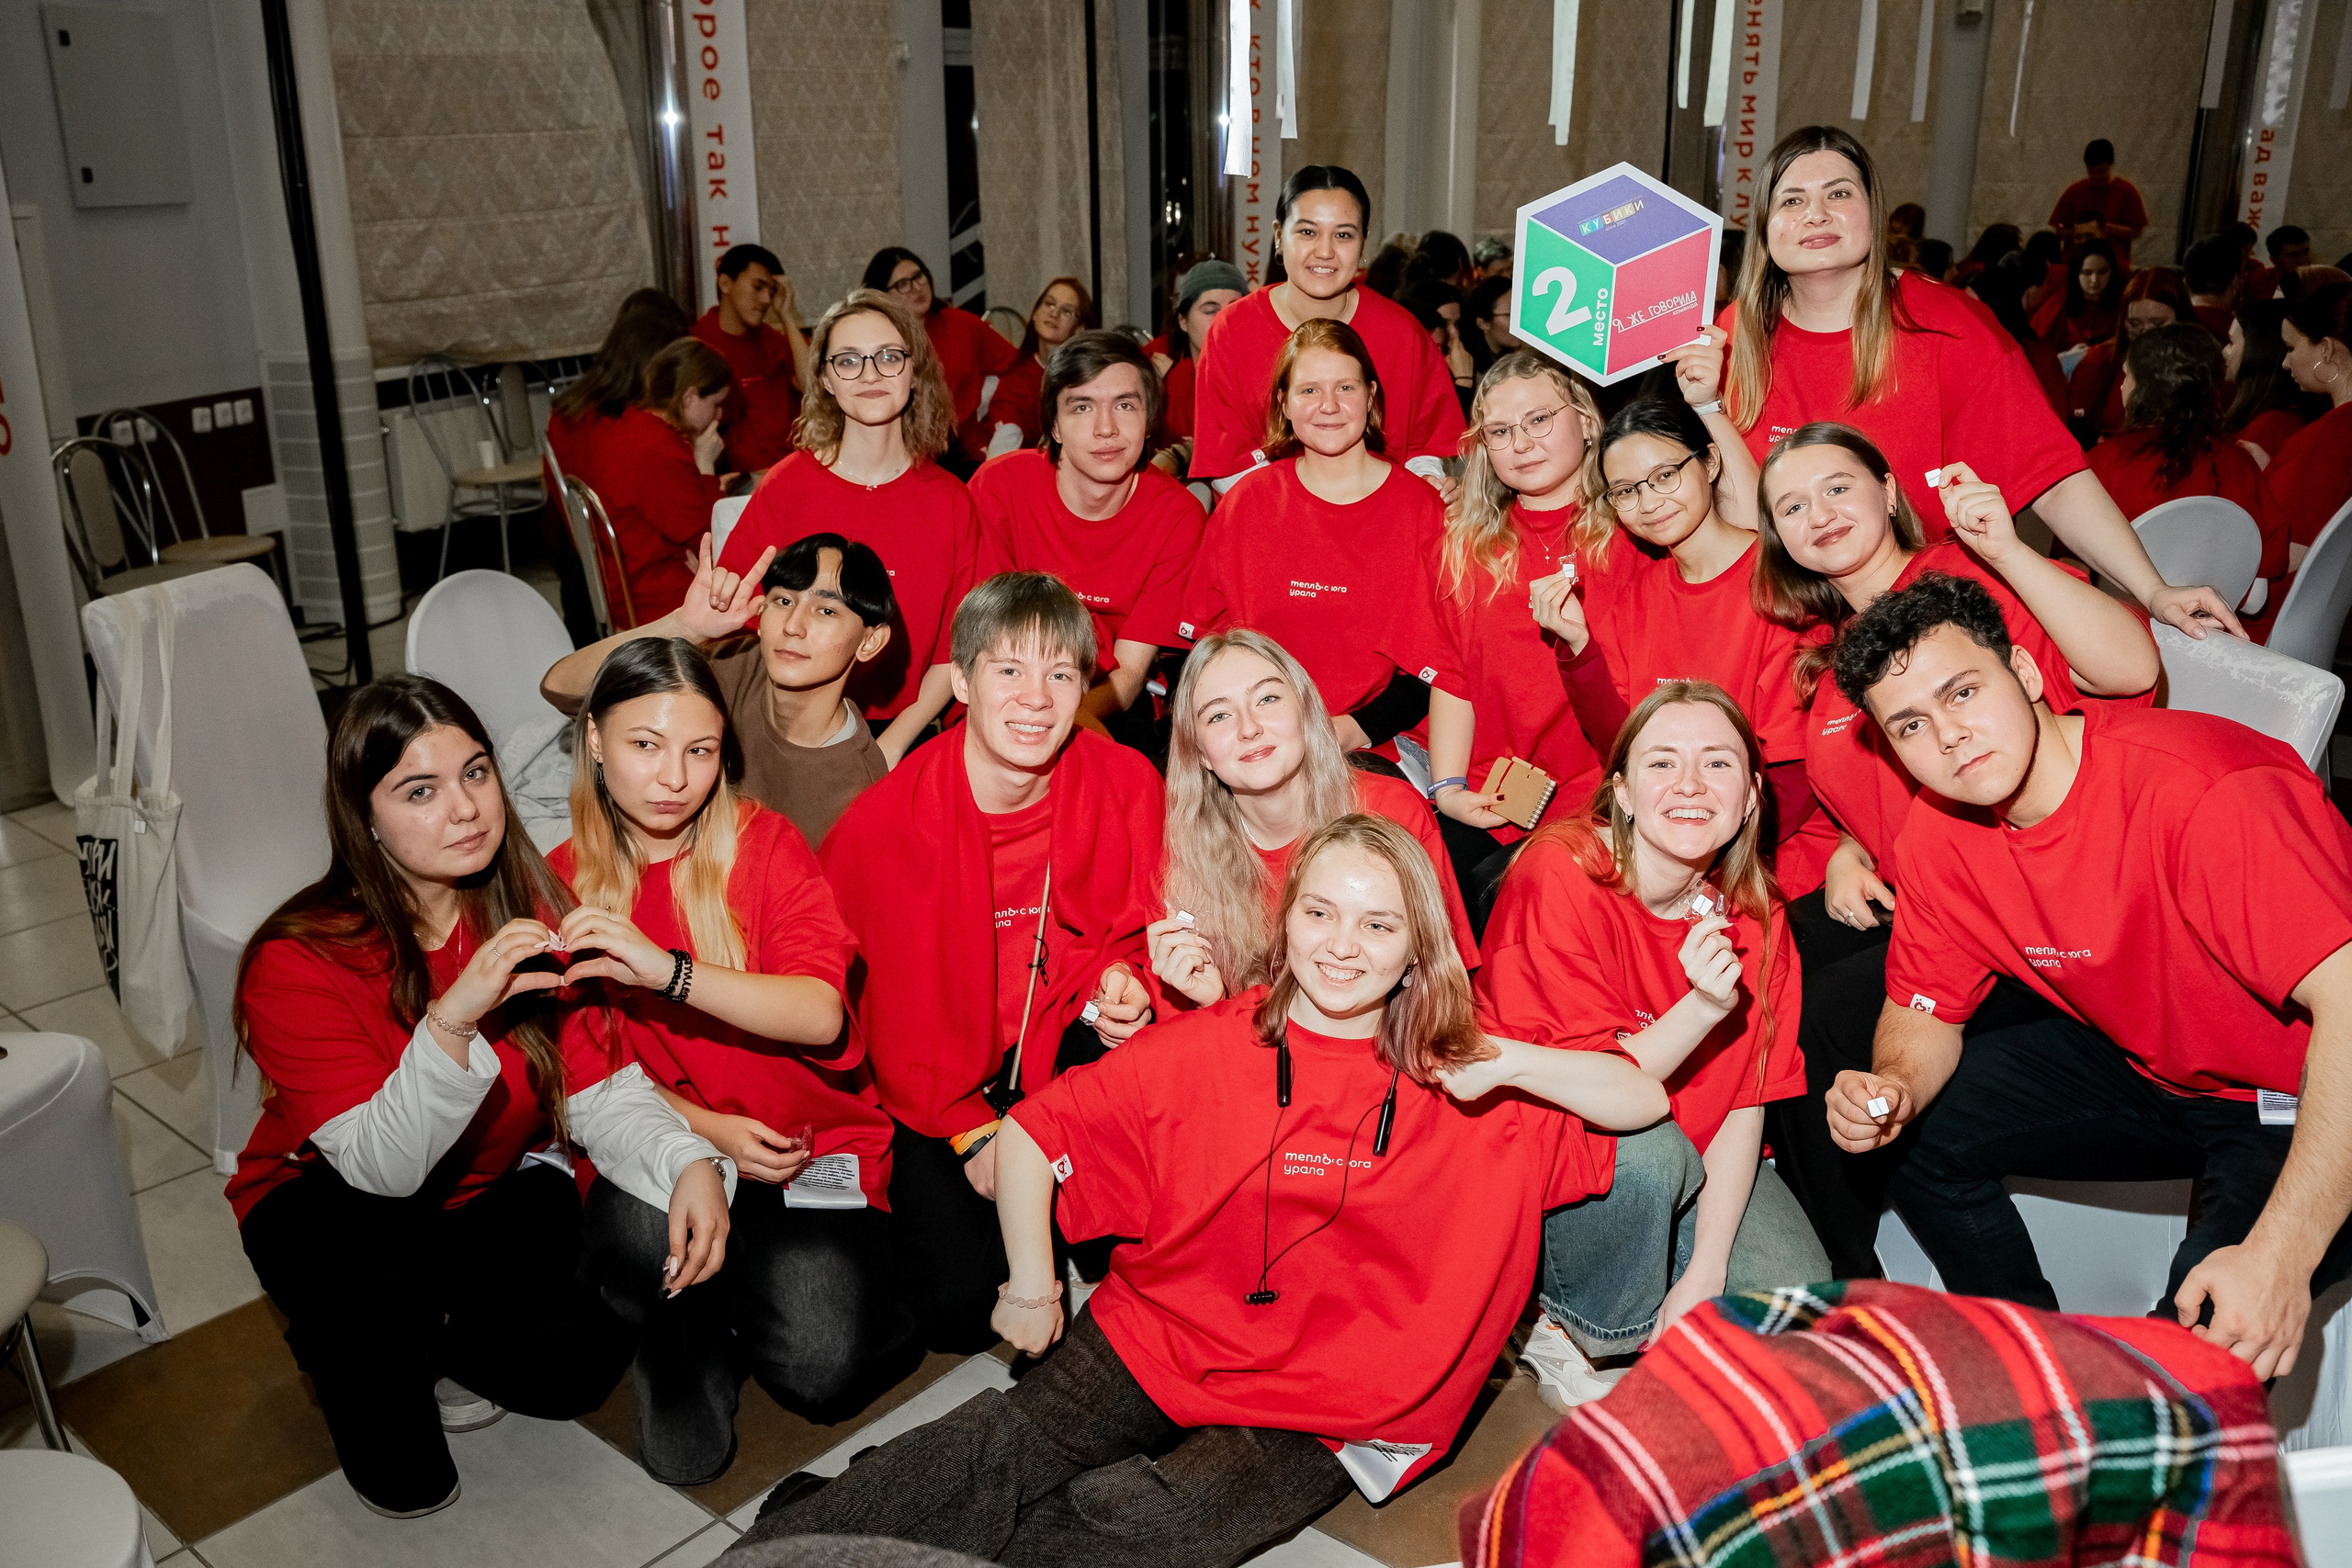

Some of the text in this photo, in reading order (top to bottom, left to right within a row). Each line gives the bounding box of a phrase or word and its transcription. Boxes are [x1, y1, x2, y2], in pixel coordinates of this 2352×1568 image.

[692, 0, 721, 101] рое
[1734, 95, 1757, 158] мир
[706, 124, 729, 200] так
[1581, 199, 1645, 233] КУБИКИ
[1532, 266, 1592, 336] 2
[1611, 290, 1698, 333] Я ЖЕ ГОВОРИЛА
